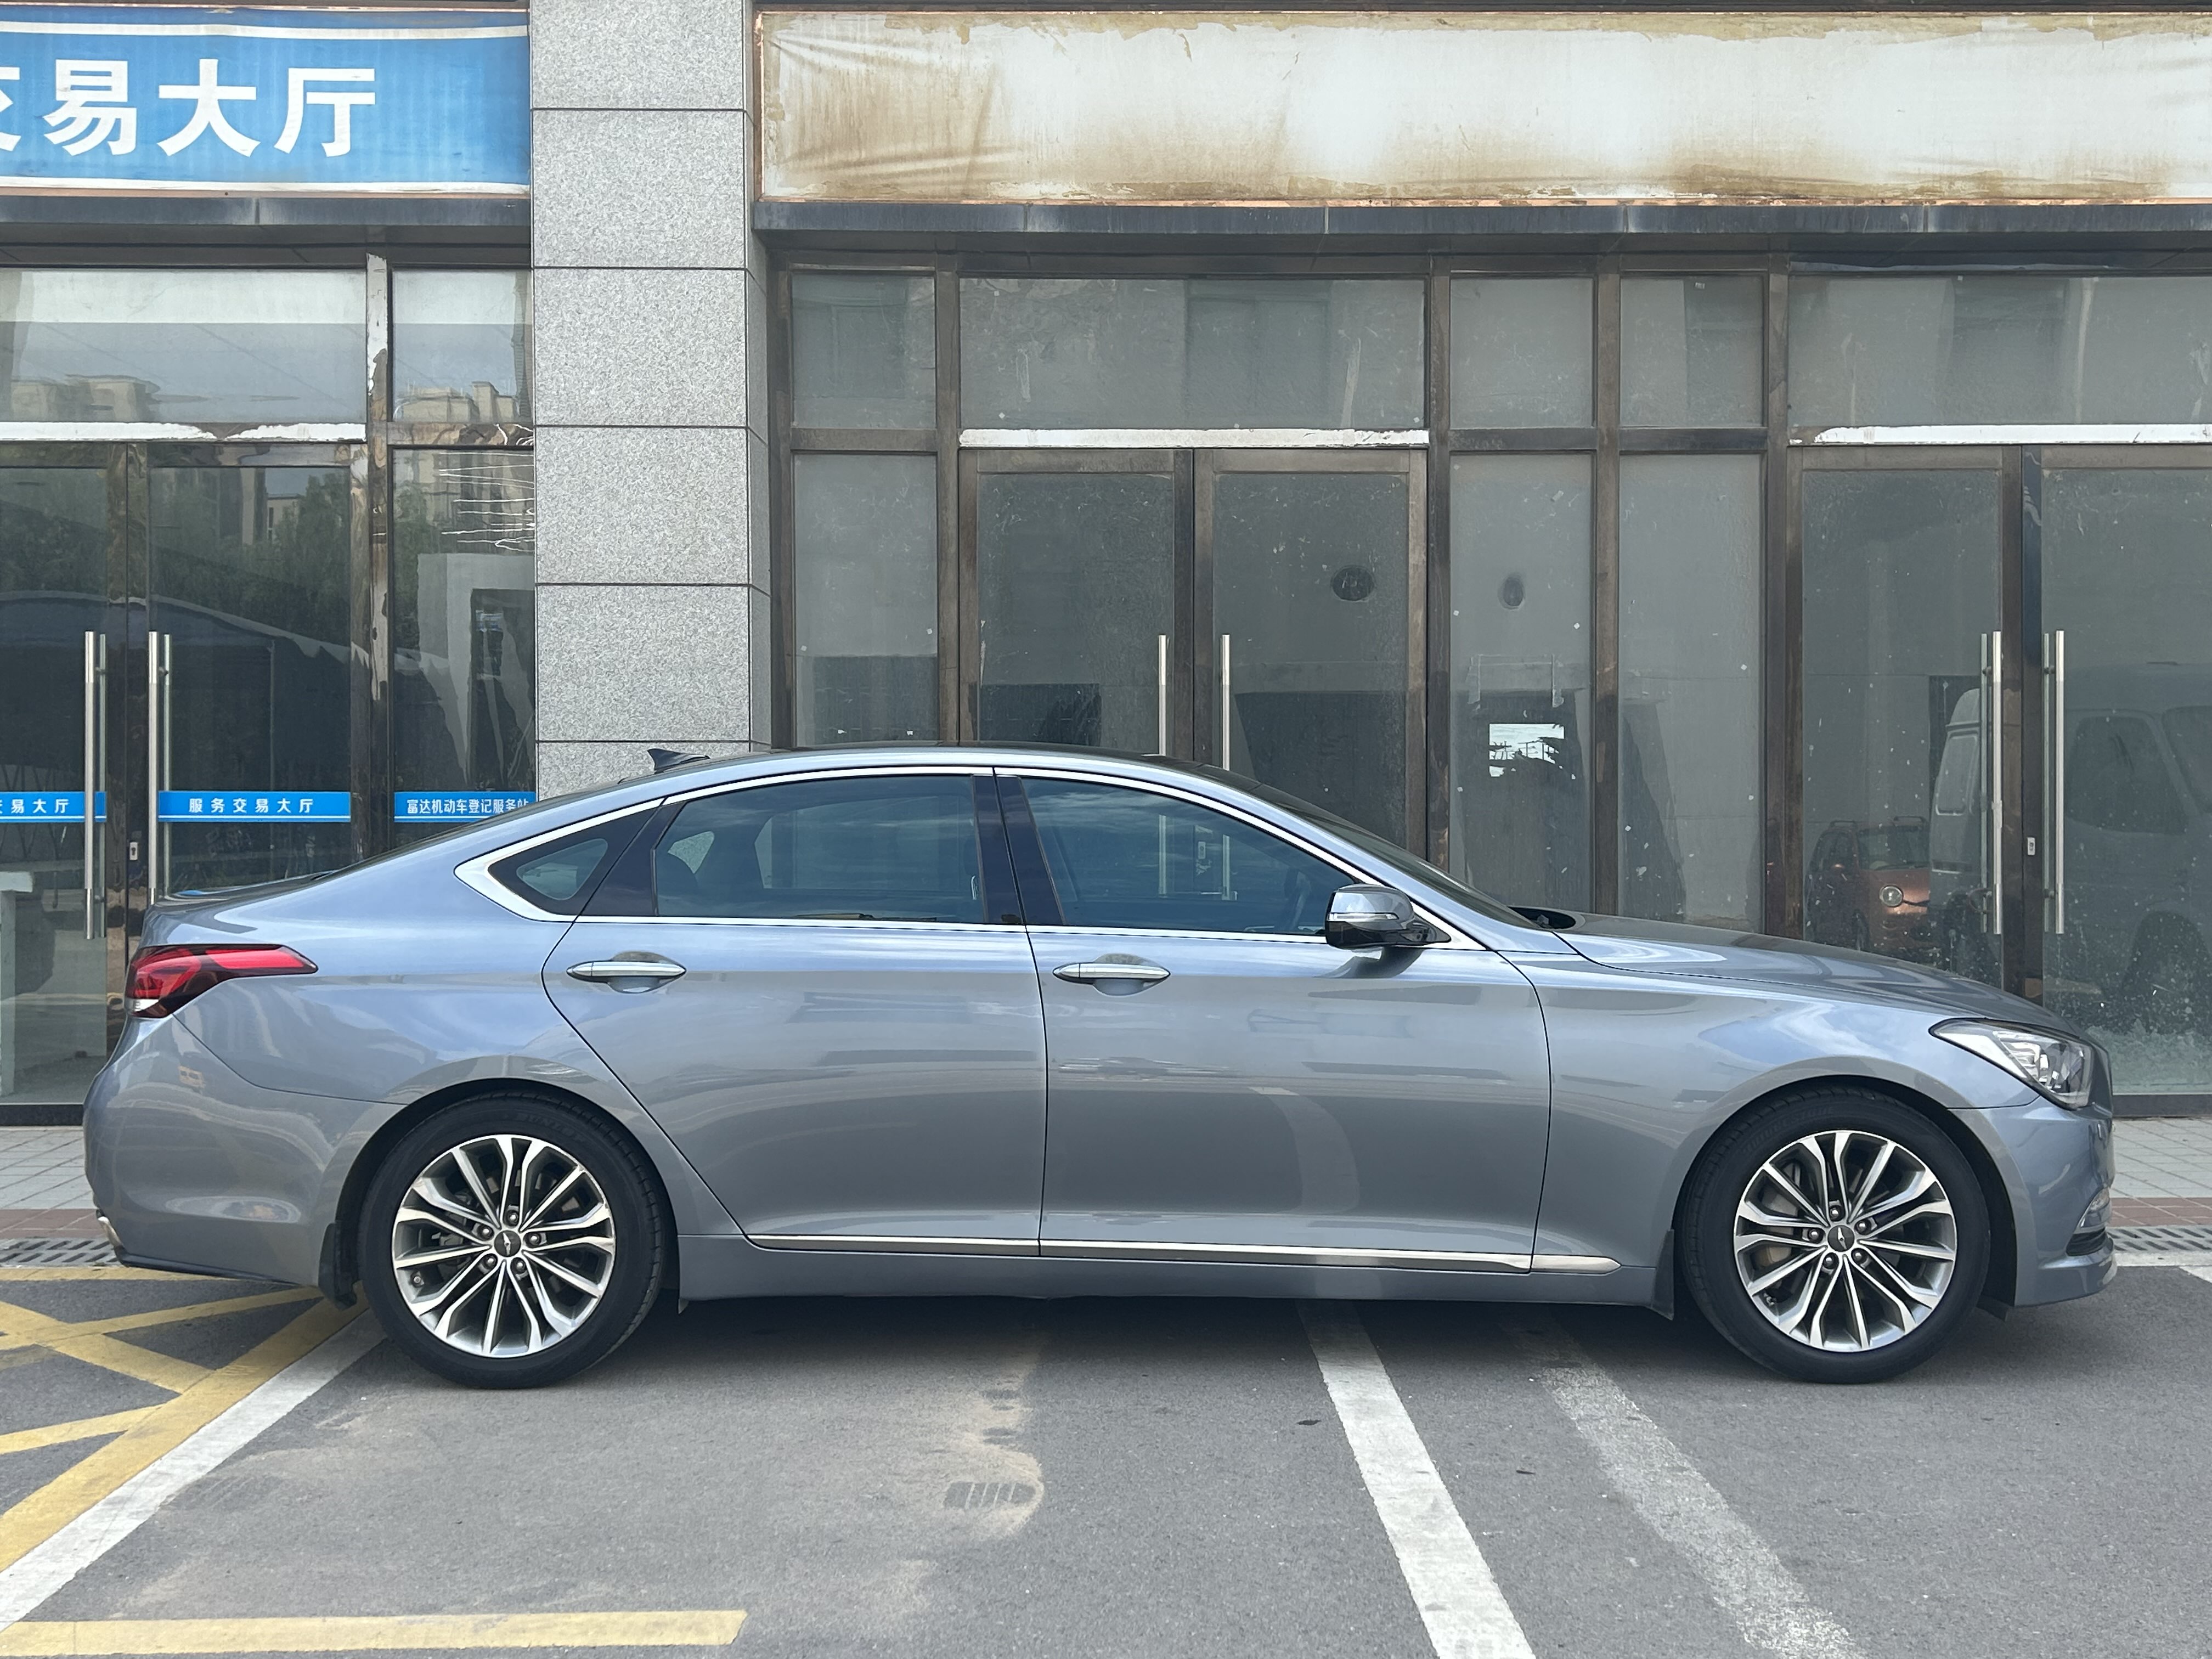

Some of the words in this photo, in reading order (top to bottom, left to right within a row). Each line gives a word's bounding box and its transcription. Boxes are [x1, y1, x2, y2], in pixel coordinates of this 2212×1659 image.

[0, 59, 376, 157] 易大厅
[0, 798, 69, 814] 易大厅
[188, 798, 314, 814] 服务交易大厅
